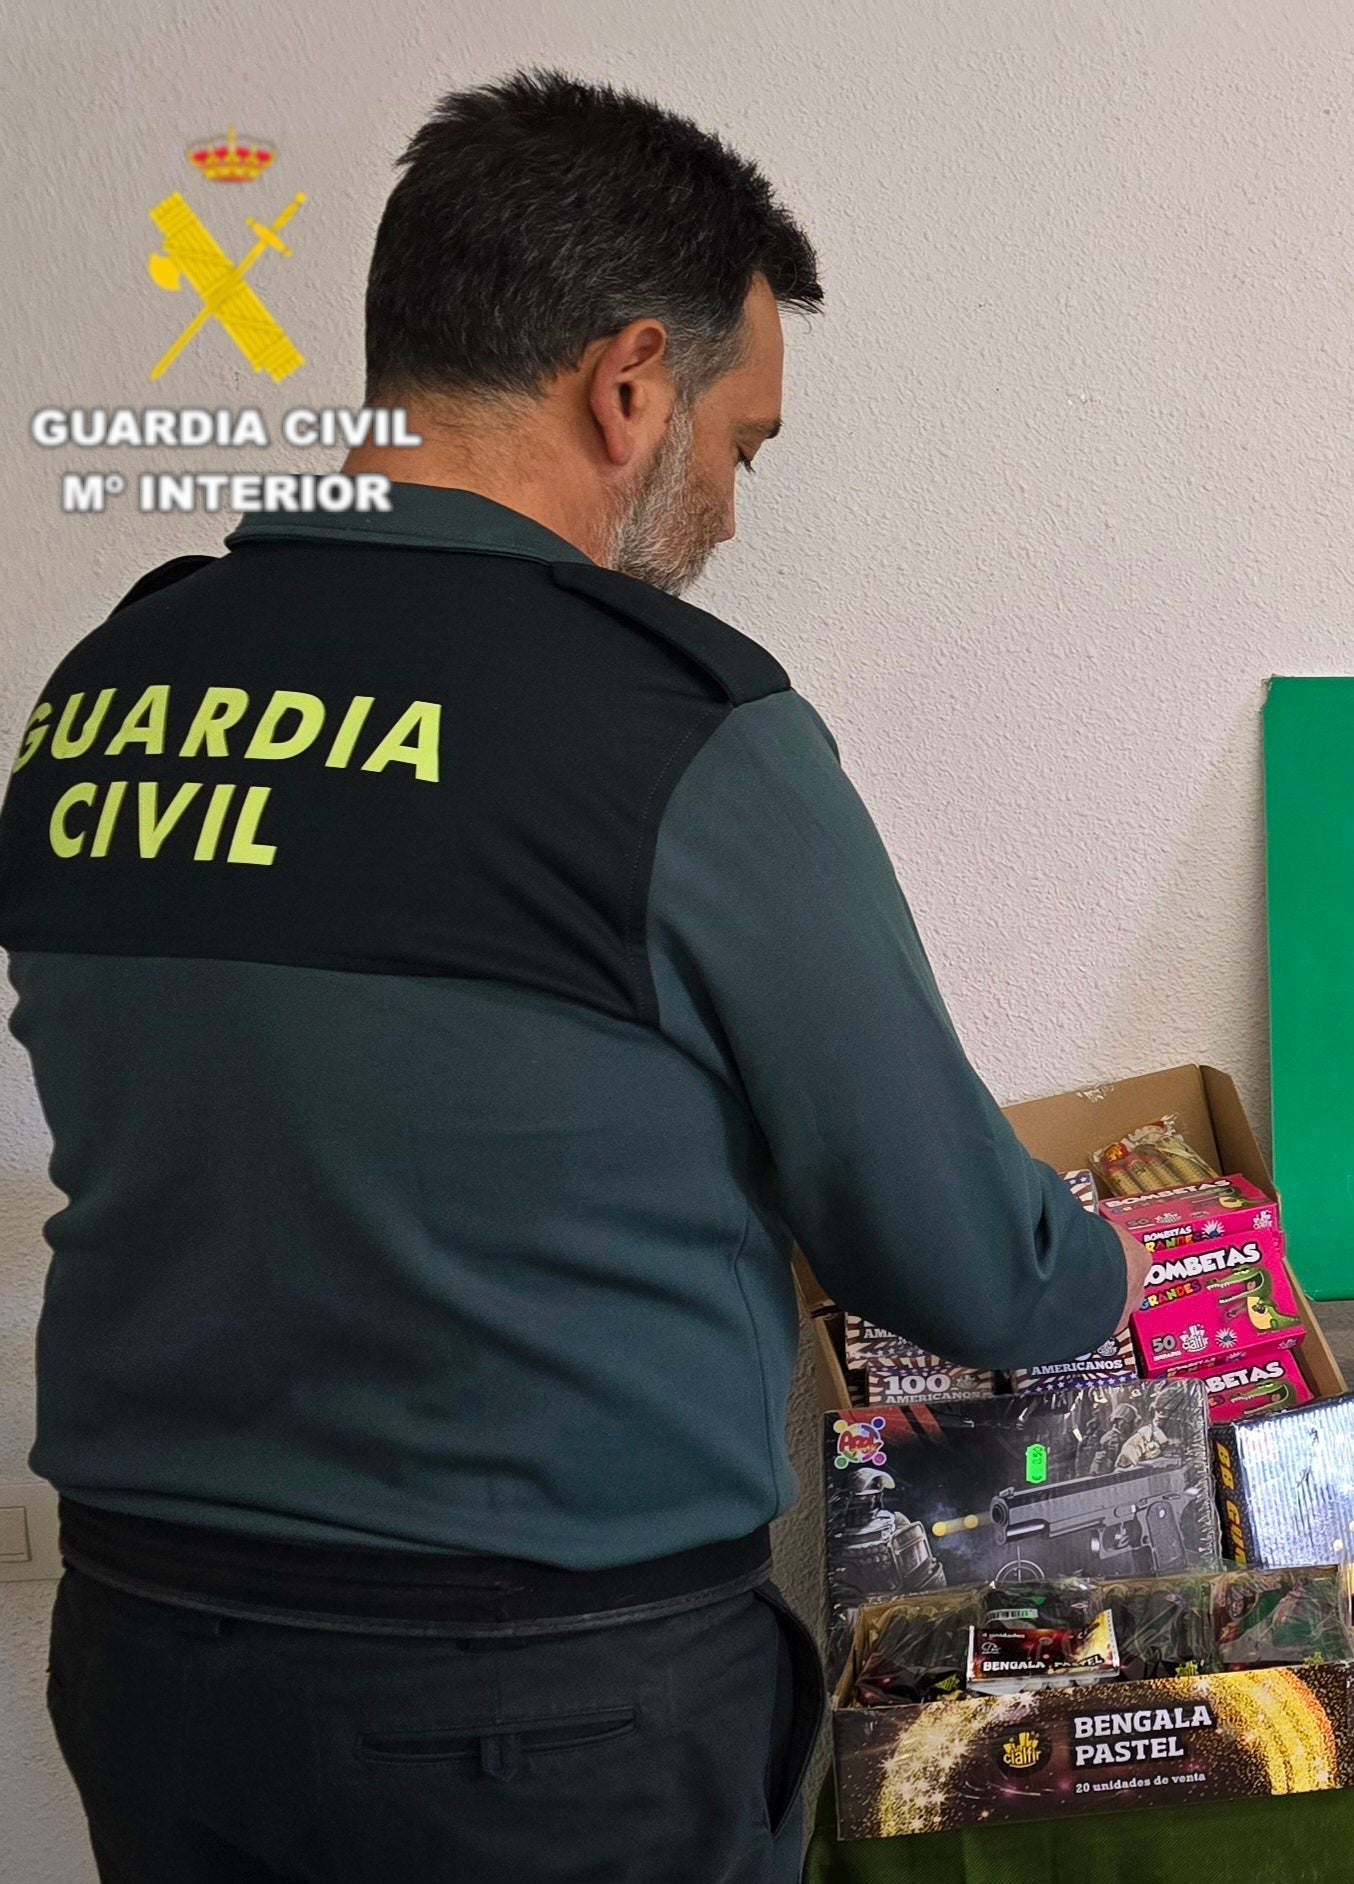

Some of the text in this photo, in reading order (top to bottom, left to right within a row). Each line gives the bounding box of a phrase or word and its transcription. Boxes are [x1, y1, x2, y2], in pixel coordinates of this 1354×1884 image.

[13, 685, 441, 782] GUARDIA
[49, 781, 277, 865] CIVIL
[1145, 1233, 1201, 1253] RANDES
[1145, 1243, 1261, 1287] OMBETAS
[1151, 1335, 1176, 1352] 50
[1031, 1359, 1123, 1376] AMERICANOS
[1206, 1361, 1285, 1392] BETAS
[884, 1374, 951, 1395] 100
[1216, 1442, 1235, 1491] BB
[983, 1660, 1045, 1672] BENGALA
[1074, 1705, 1212, 1738] BENGALA
[1076, 1737, 1184, 1766] PASTEL
[1075, 1773, 1206, 1794] 20 unidades de venta
